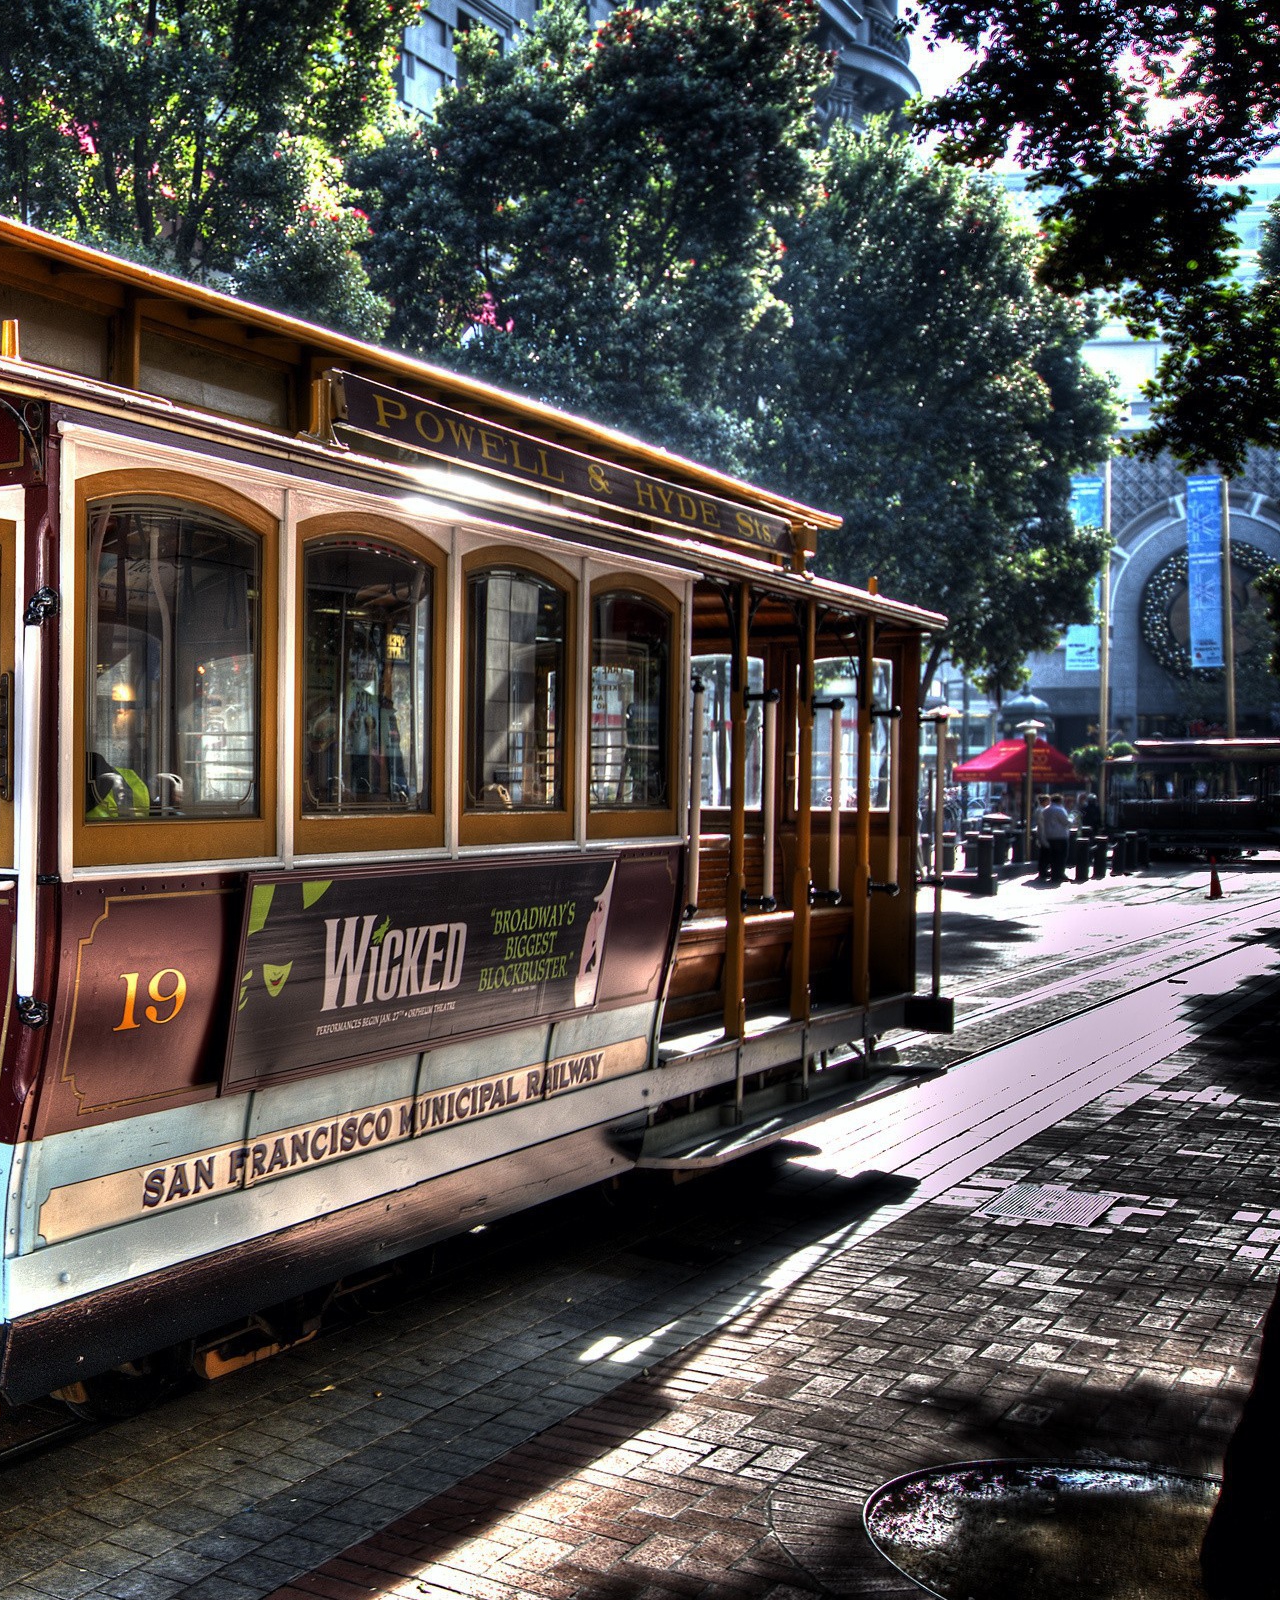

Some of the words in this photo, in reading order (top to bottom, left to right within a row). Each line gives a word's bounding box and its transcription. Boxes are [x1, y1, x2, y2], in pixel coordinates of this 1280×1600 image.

[372, 393, 566, 484] POWELL
[587, 463, 613, 495] &
[634, 477, 719, 528] HYDE
[735, 510, 777, 545] Sts.
[504, 930, 558, 960] BIGGEST
[112, 968, 188, 1032] 19
[316, 1019, 362, 1036] PERFORMANCES
[362, 1015, 380, 1028] BEGIN
[408, 1005, 433, 1019] ORPHEUM
[433, 1001, 456, 1015] THEATRE
[143, 1154, 215, 1209] SAN
[229, 1107, 392, 1184] FRANCISCO
[399, 1074, 520, 1138] MUNICIPAL
[526, 1052, 604, 1099] RAILWAY
